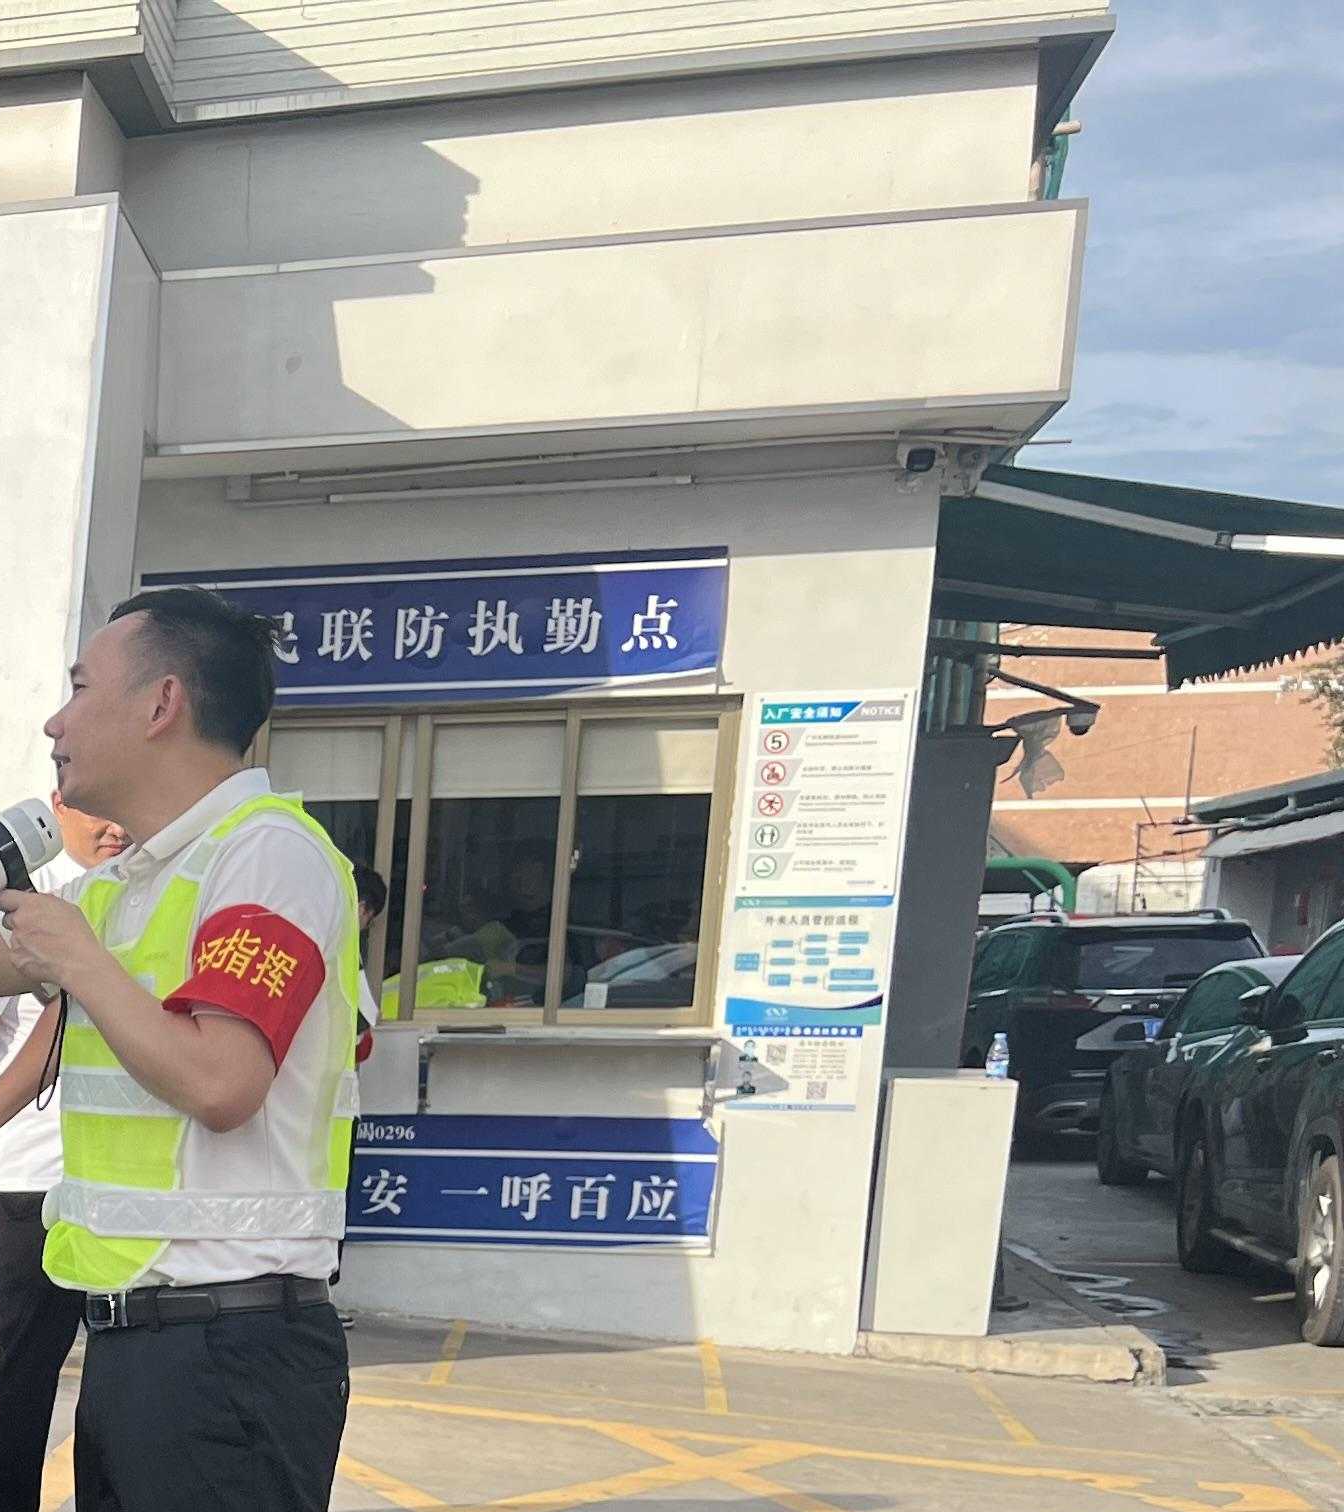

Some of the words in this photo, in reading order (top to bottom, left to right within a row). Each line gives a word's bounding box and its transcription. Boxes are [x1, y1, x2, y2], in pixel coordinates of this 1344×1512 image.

[764, 706, 842, 720] 入厂安全须知
[861, 705, 901, 717] NOTICE
[361, 1169, 408, 1216] 安
[440, 1172, 679, 1222] 一呼百应
